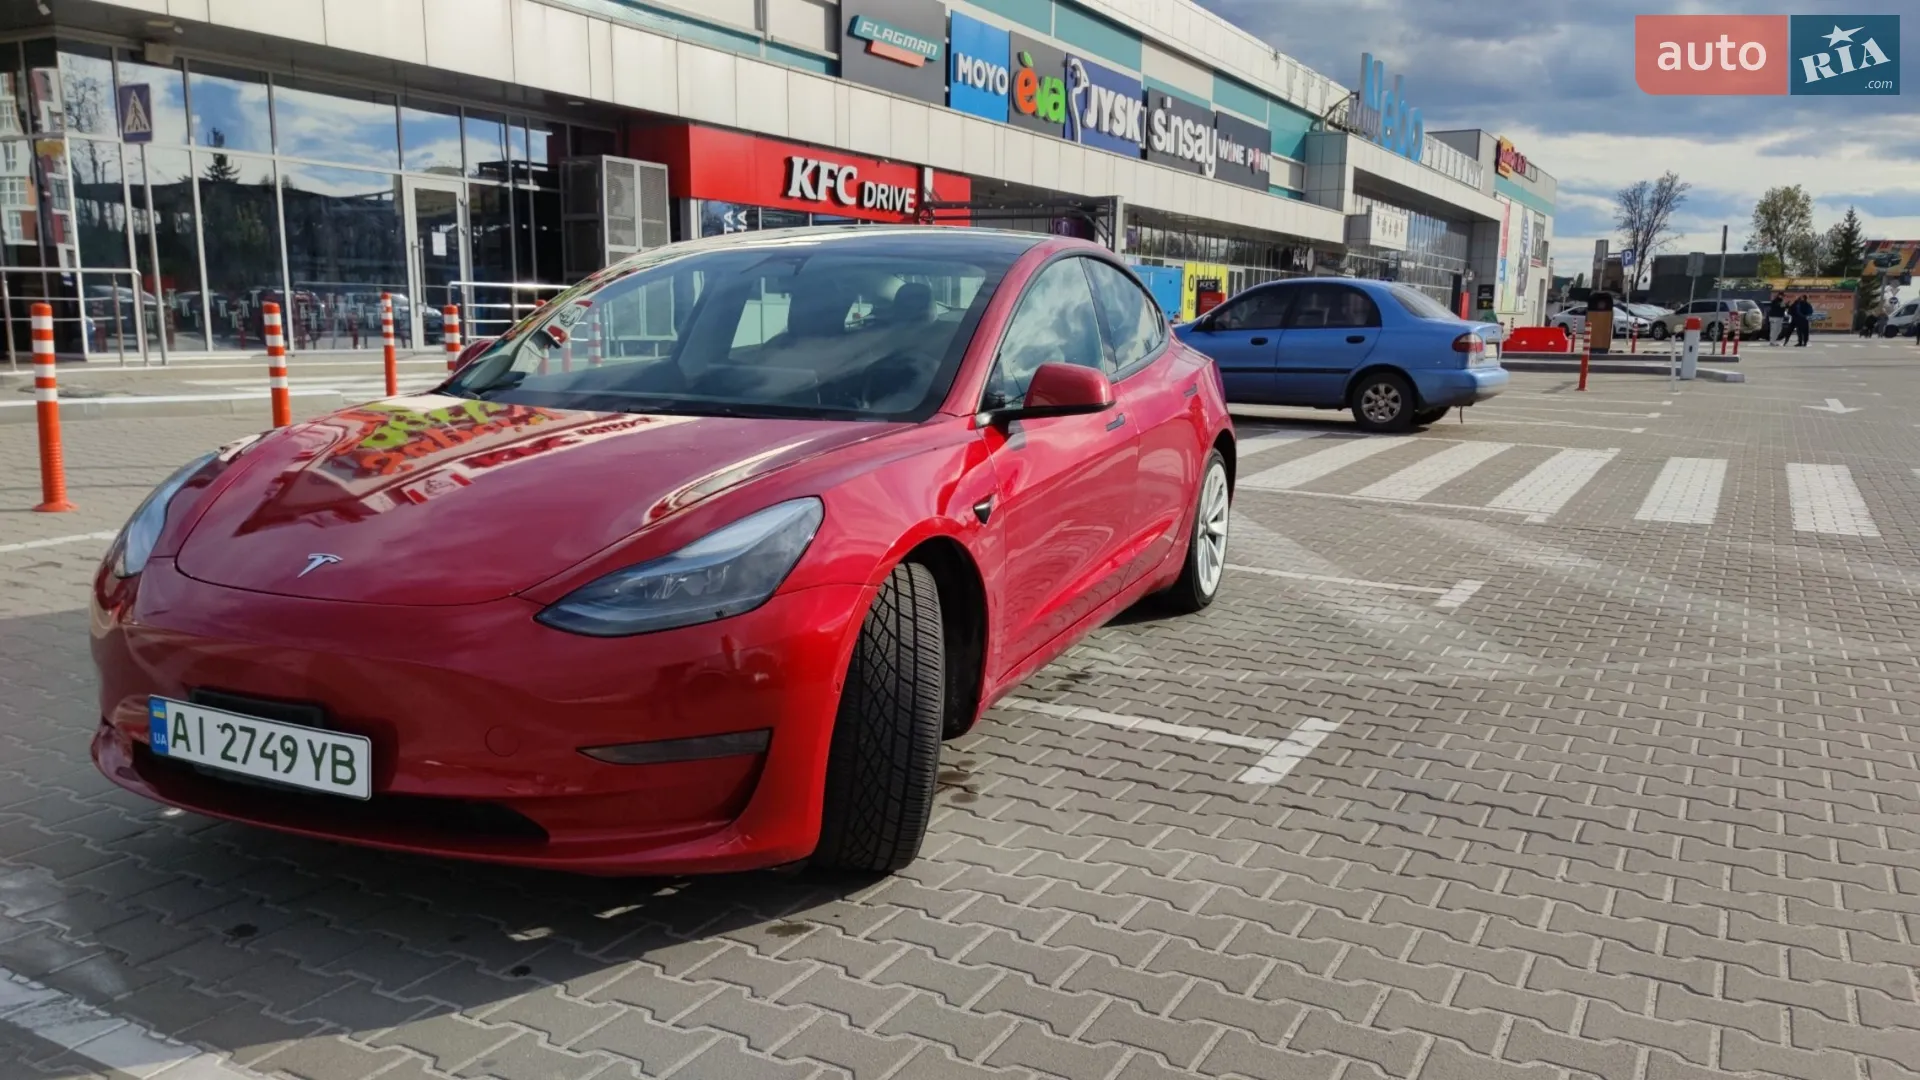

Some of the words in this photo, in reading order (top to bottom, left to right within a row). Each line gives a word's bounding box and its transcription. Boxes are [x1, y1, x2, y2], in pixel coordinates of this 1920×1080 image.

[861, 21, 937, 56] FLAGMAN
[957, 52, 1009, 95] MOYO
[1085, 83, 1143, 143] JYSK
[1153, 96, 1218, 179] sinsay
[1218, 137, 1246, 166] WINE
[788, 155, 858, 206] KFC
[863, 180, 917, 214] DRIVE
[1625, 250, 1633, 265] P
[1199, 280, 1216, 288] KFC
[153, 732, 168, 747] UA
[219, 722, 299, 774] 2749
[307, 738, 357, 787] YB
